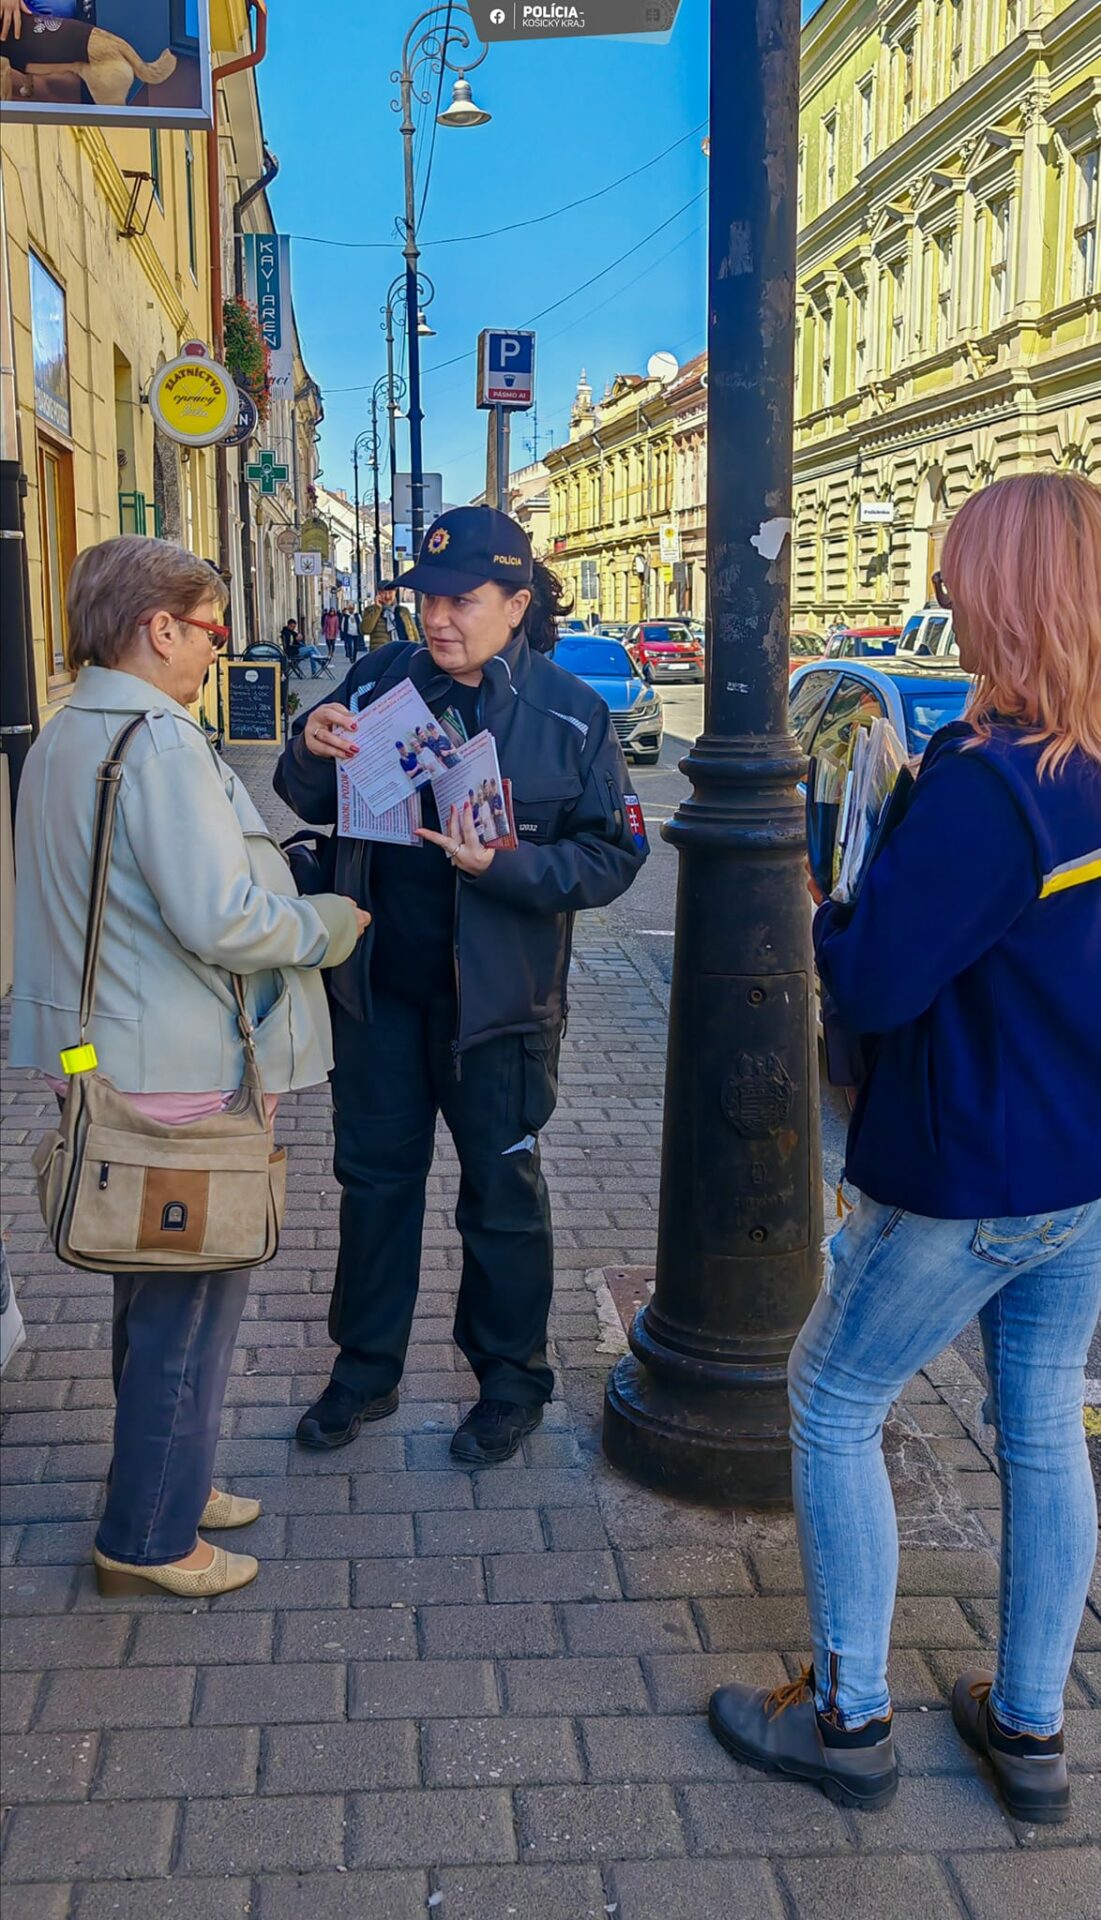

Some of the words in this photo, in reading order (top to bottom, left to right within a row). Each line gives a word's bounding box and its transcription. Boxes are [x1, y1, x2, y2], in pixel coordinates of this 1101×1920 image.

[500, 338, 521, 368] P
[165, 367, 221, 395] ZLATNÍCTVO
[493, 390, 518, 399] PÁSMO
[493, 554, 522, 566] POLÍCIA
